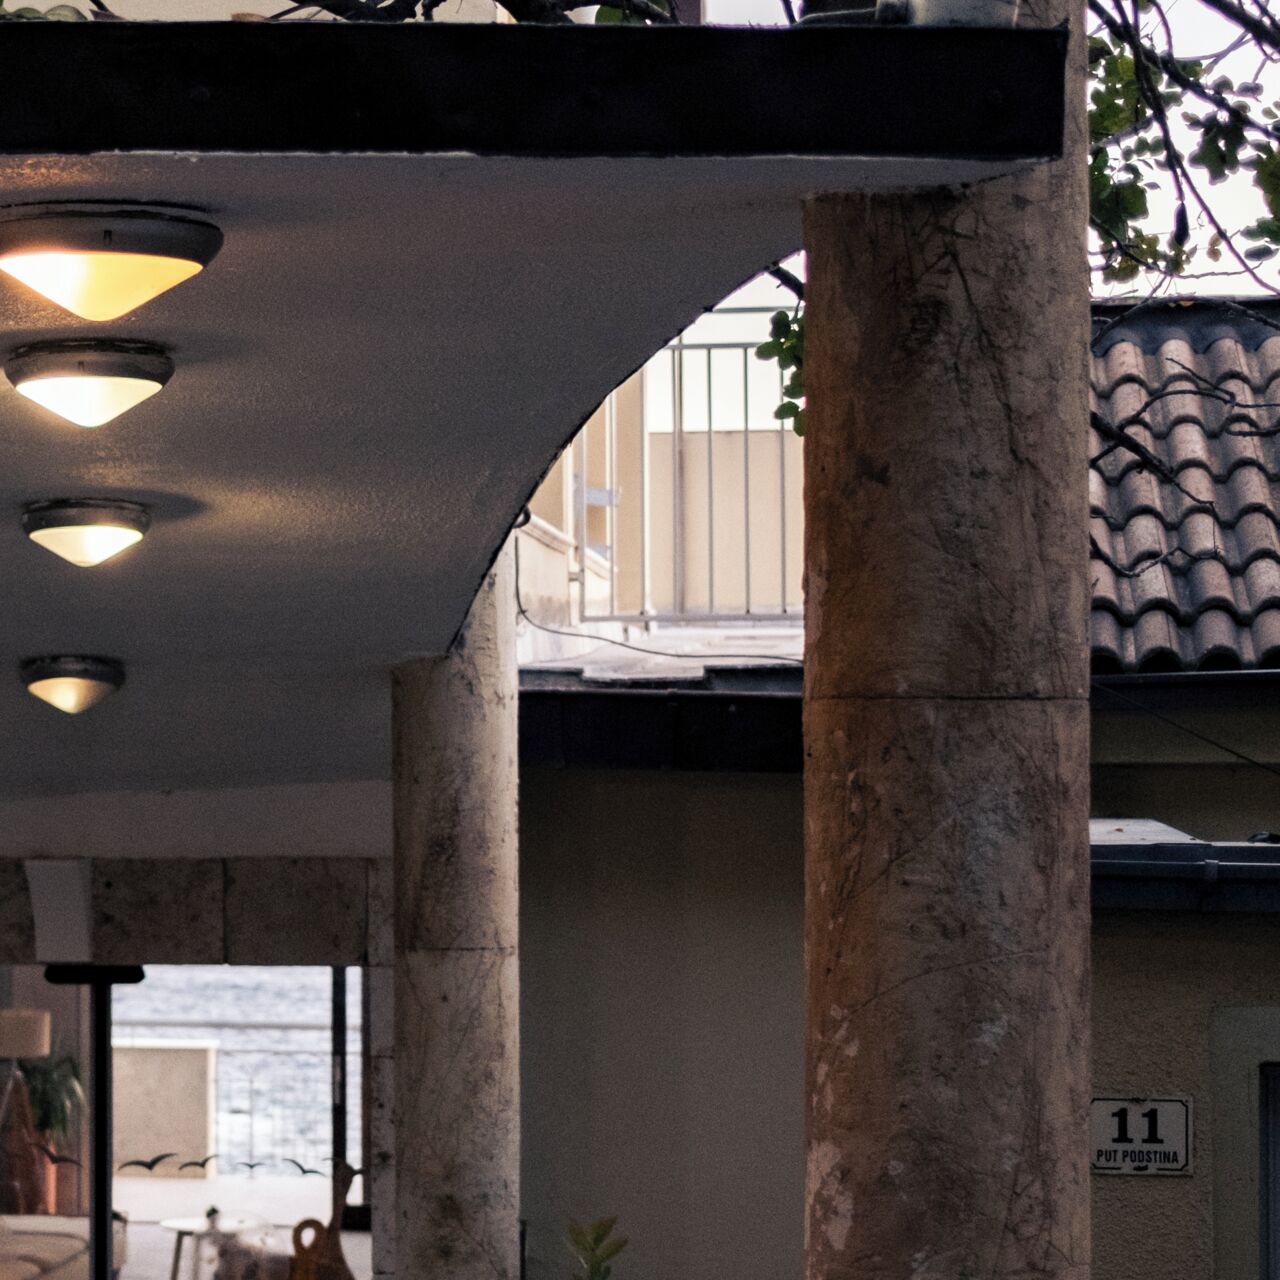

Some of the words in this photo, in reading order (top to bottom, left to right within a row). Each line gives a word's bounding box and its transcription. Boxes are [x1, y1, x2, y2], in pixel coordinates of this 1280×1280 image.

[1111, 1107, 1164, 1145] 11
[1096, 1149, 1118, 1162] PUT
[1122, 1150, 1179, 1164] PODSTINA
